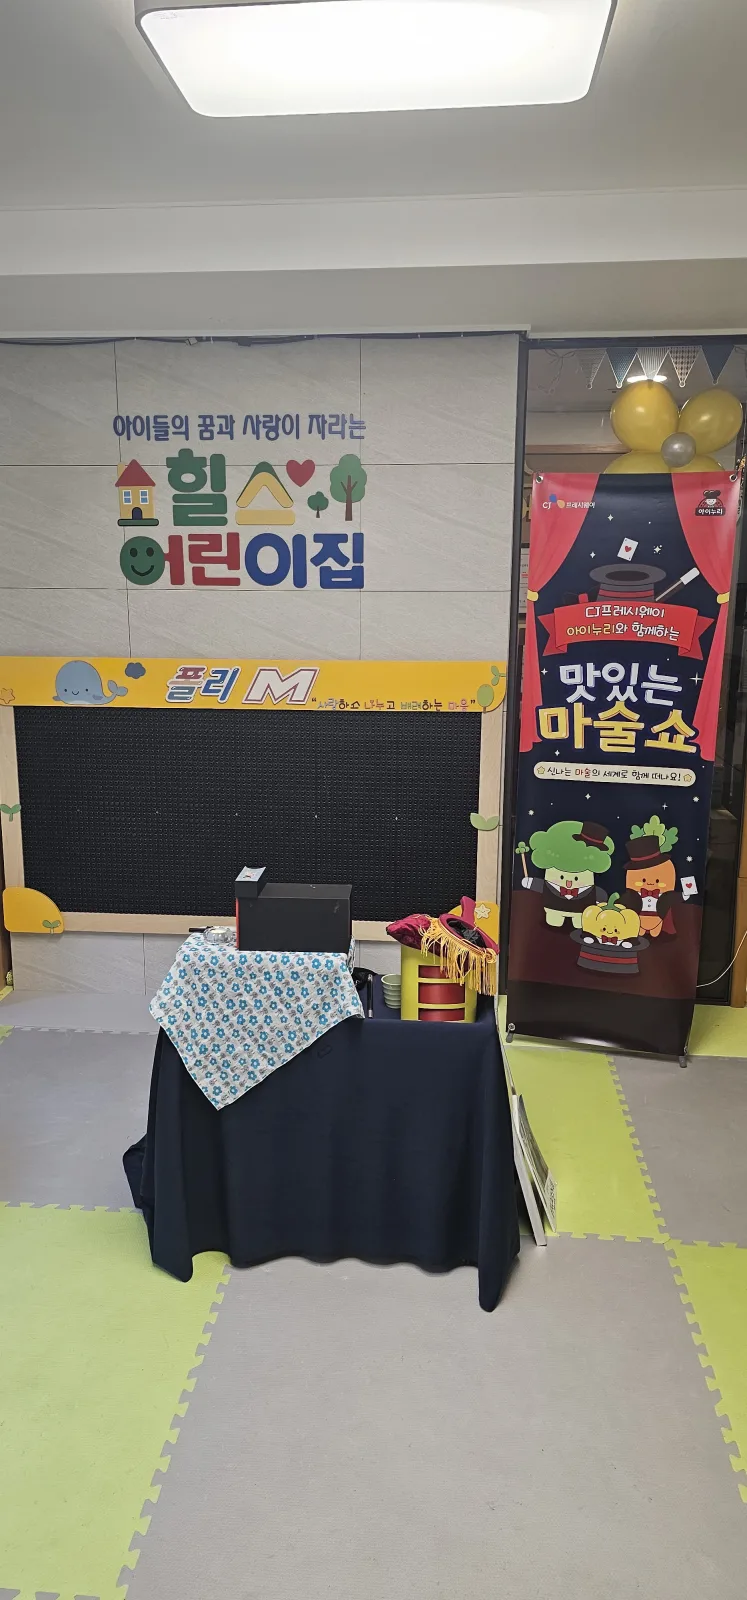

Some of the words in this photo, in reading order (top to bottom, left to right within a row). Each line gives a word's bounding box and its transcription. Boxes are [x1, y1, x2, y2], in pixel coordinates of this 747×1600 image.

[113, 414, 190, 442] 아이들의
[198, 414, 235, 441] 꿈과
[242, 413, 300, 441] 사랑이
[308, 413, 367, 440] 자라는
[166, 448, 296, 527] 힐스
[542, 501, 552, 510] CJ
[566, 501, 596, 509] 프레시웨이
[119, 532, 365, 589] 어린이집
[585, 604, 665, 618] CJ프레시웨이
[566, 622, 628, 635] 아이누리와
[632, 622, 680, 641] 함께하는
[165, 665, 241, 704] 플리
[241, 666, 321, 706] M
[559, 662, 683, 707] 맛있는
[400, 699, 443, 712] 배려하는
[538, 701, 698, 754] 마술쇼
[547, 766, 572, 777] 신나는
[574, 767, 600, 779] 마술의
[603, 769, 629, 779] 세계로
[631, 769, 650, 780] 함께
[651, 772, 682, 782] 떠나요!
